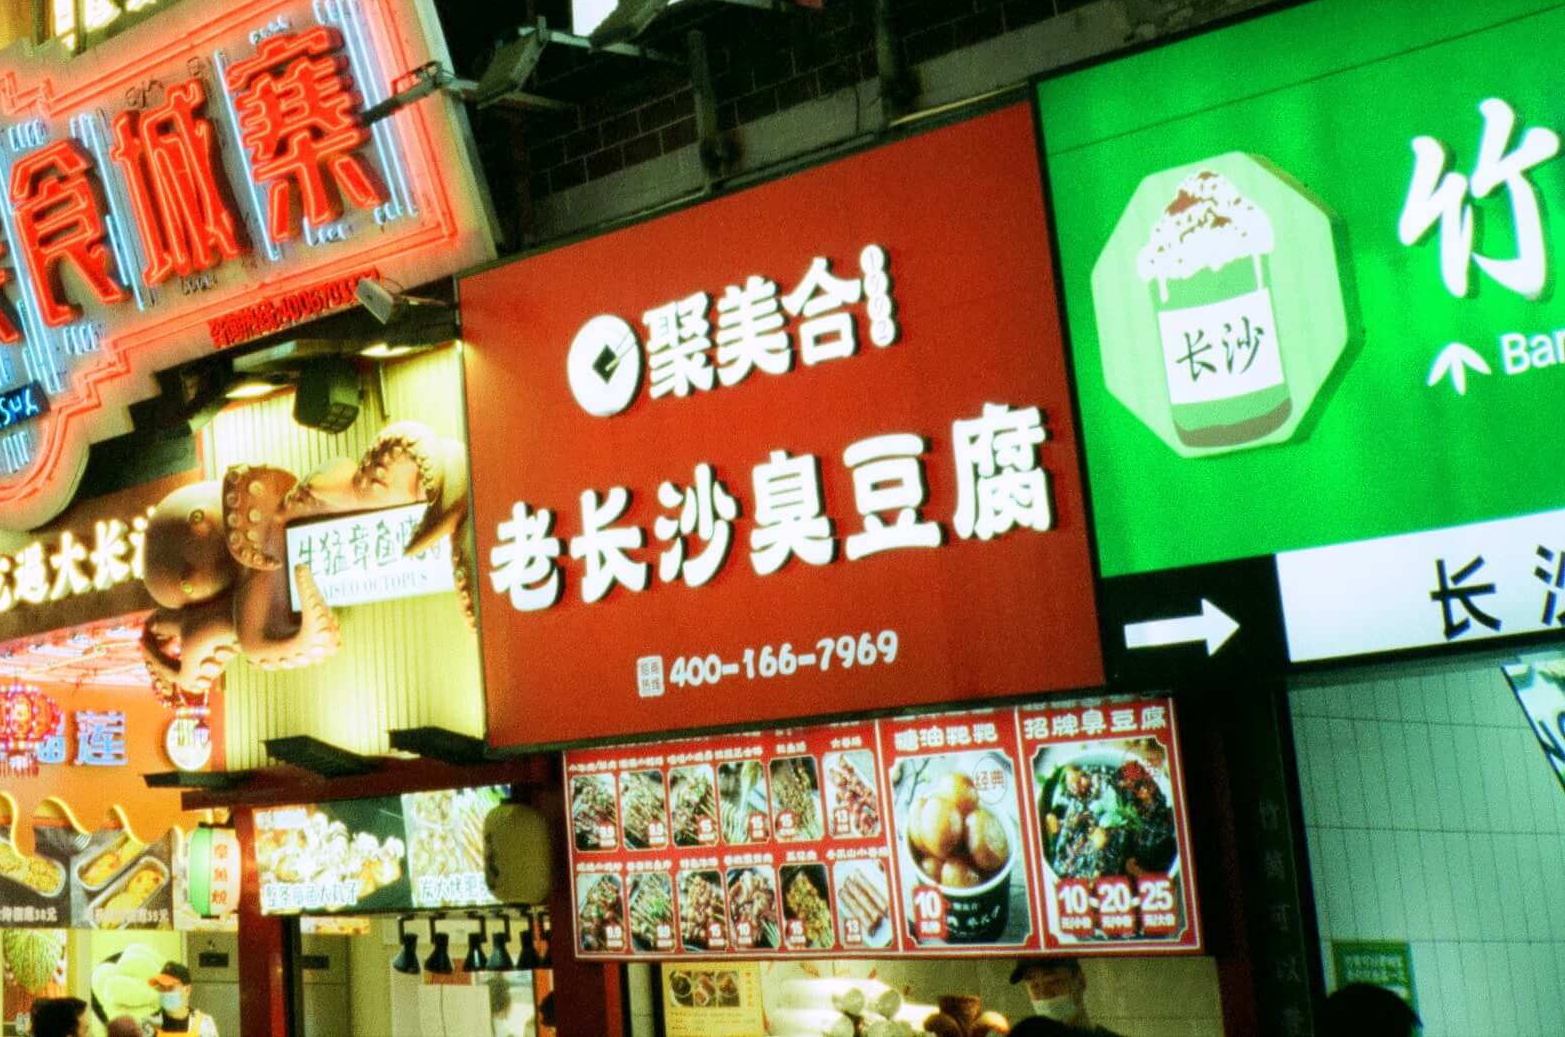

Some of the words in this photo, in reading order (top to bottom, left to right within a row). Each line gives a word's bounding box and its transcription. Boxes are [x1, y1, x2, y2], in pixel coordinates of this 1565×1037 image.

[642, 255, 865, 402] 聚美合
[1176, 316, 1265, 383] 长沙
[489, 402, 1052, 612] 老长沙臭豆腐
[670, 629, 899, 688] 400-166-7969
[1024, 705, 1168, 741] 招牌臭豆腐
[914, 890, 942, 914] 10
